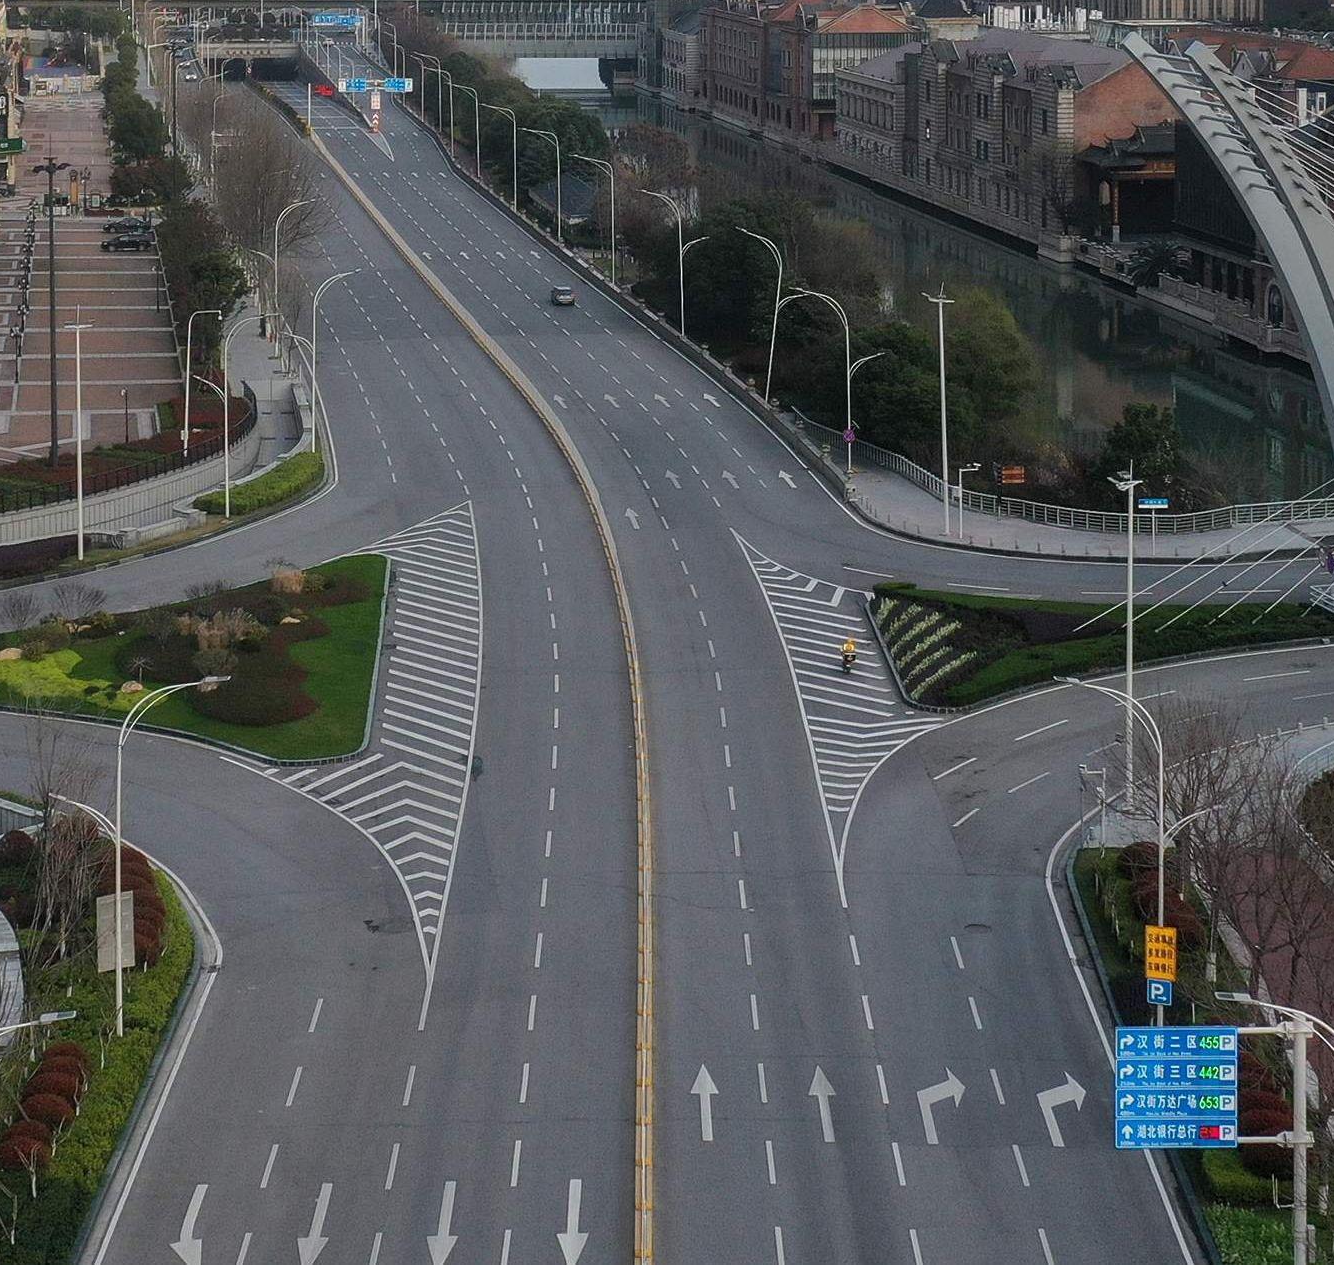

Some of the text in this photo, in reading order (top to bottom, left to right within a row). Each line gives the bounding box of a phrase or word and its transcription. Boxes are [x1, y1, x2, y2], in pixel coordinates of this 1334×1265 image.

[1137, 1035, 1197, 1049] 汉街二区
[1199, 1036, 1220, 1049] 455
[1137, 1064, 1197, 1079] 汉街三区
[1199, 1066, 1220, 1079] 442
[1137, 1094, 1197, 1109] 汉街万达广场
[1199, 1096, 1220, 1109] 653
